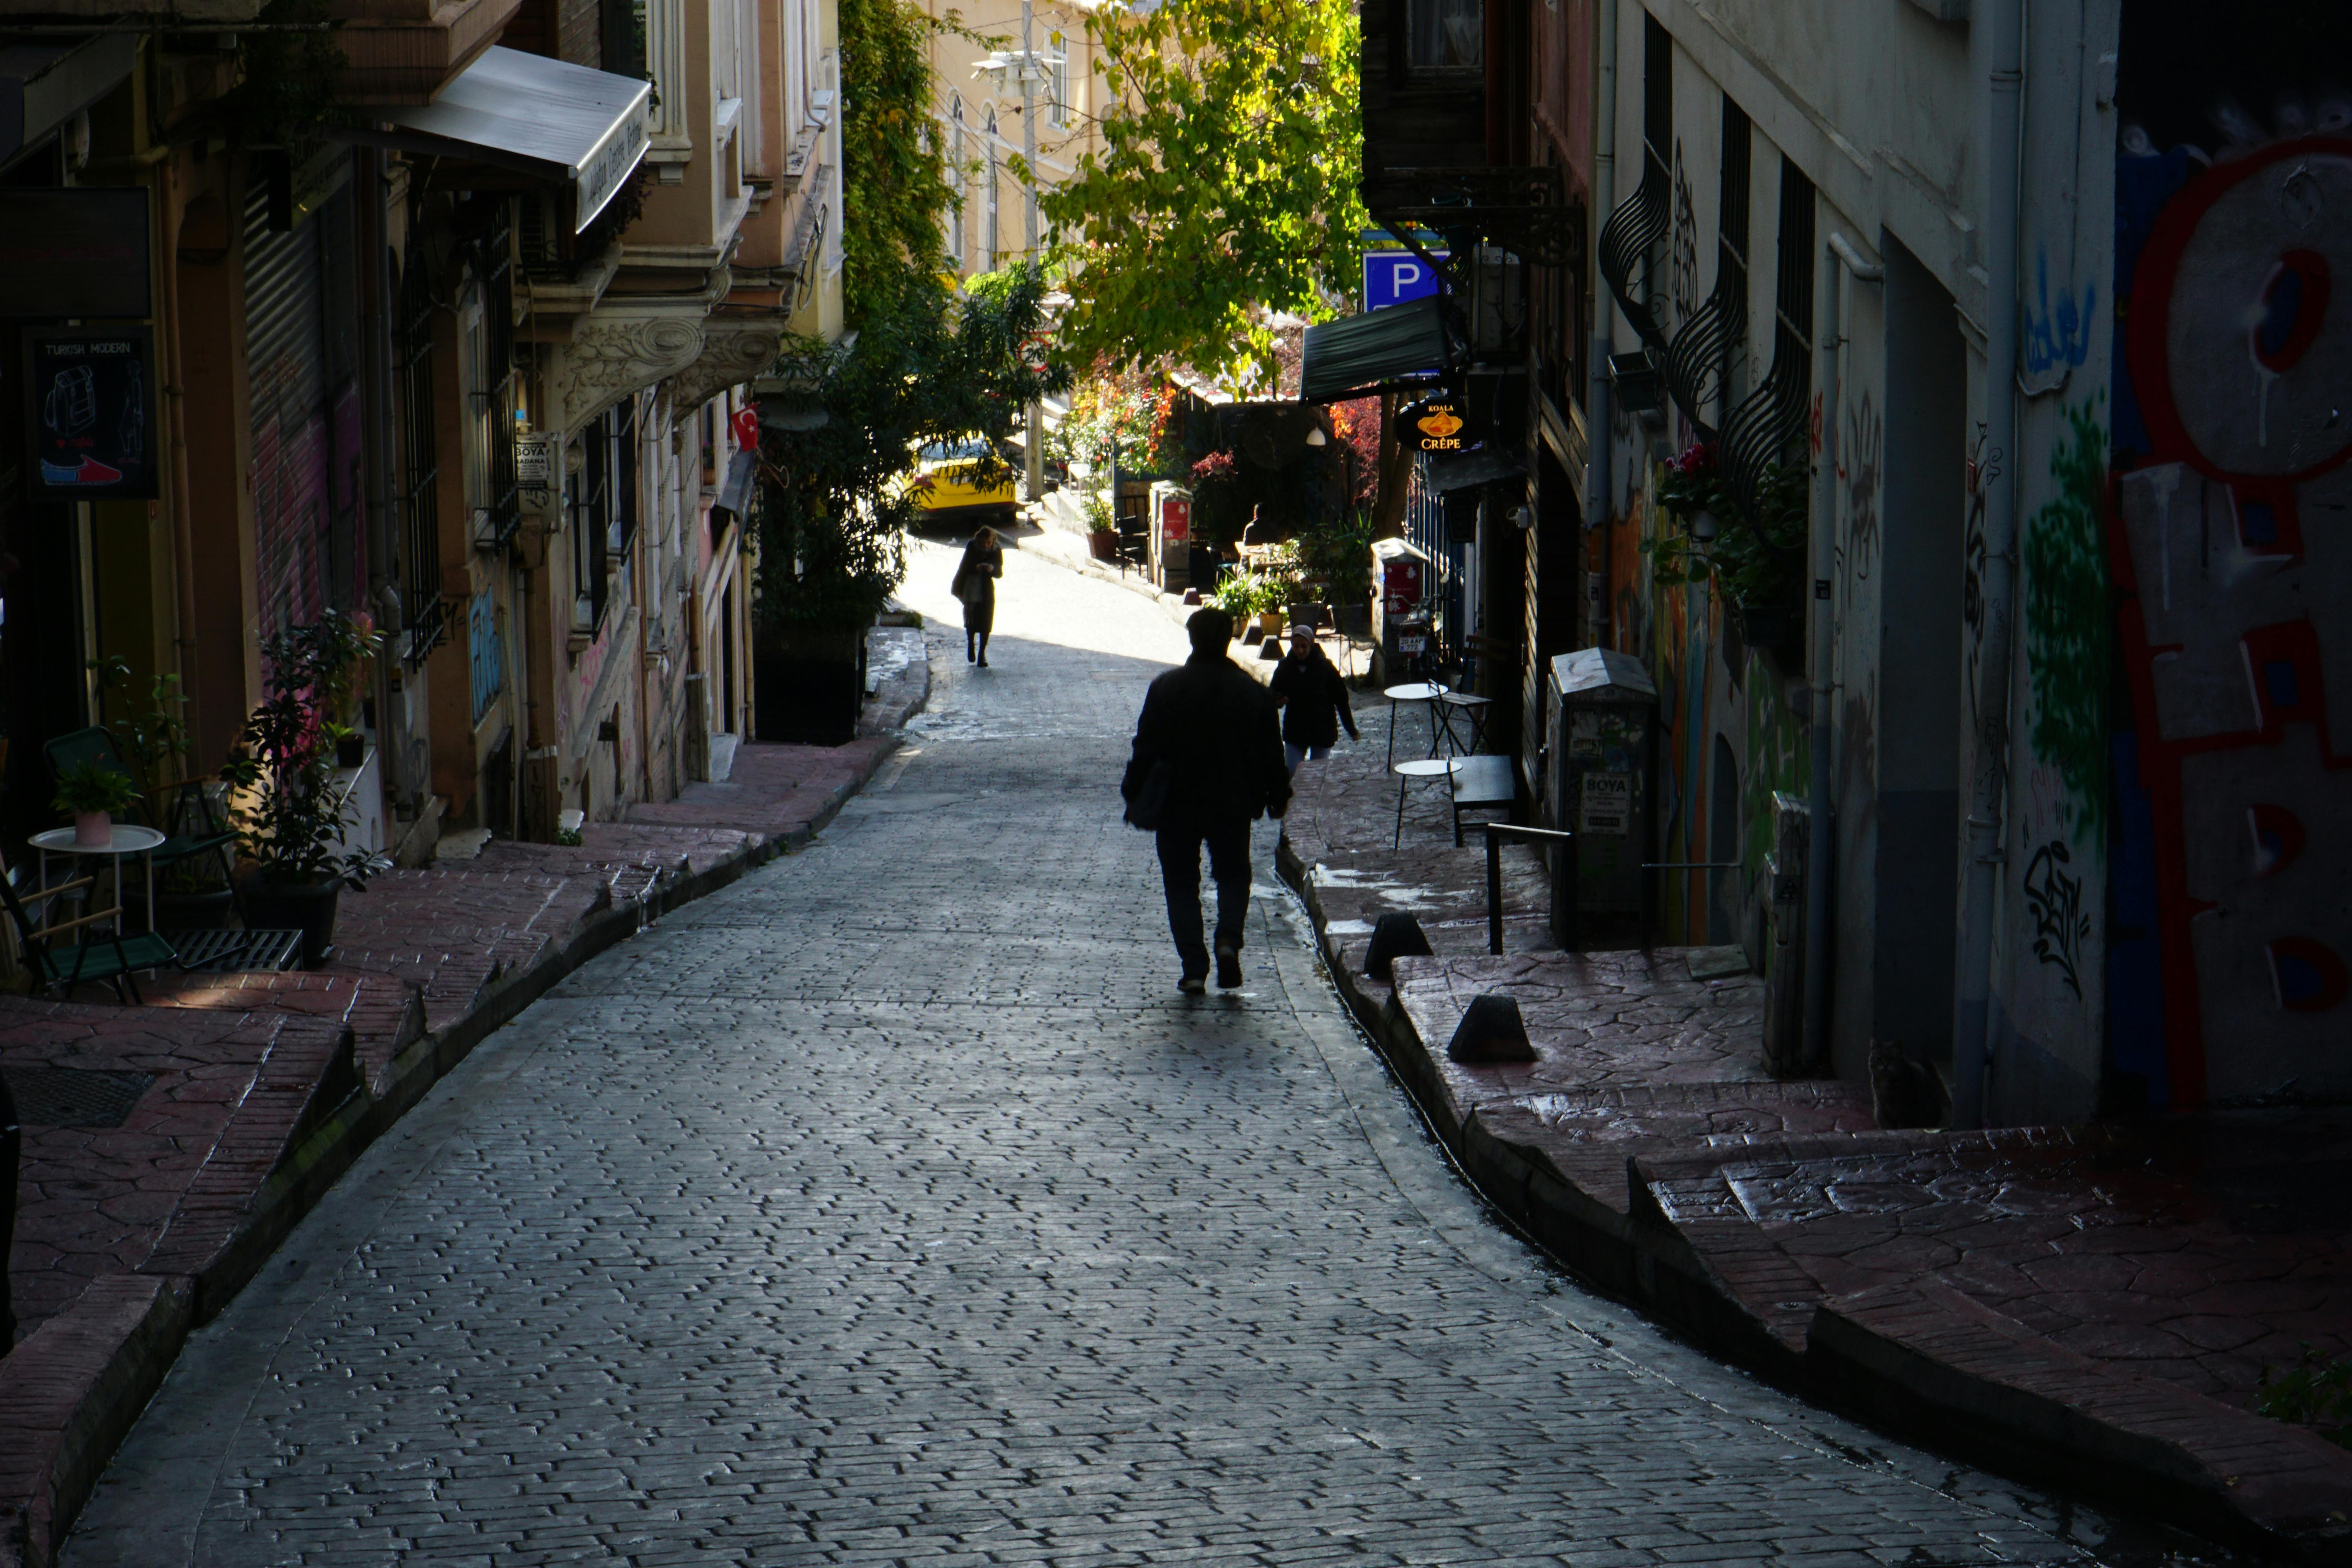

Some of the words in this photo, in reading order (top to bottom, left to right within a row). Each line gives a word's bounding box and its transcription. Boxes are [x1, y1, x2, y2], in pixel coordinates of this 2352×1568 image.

[1394, 263, 1420, 298] P
[45, 344, 84, 355] TURKISH
[91, 343, 130, 354] MODERN
[1421, 437, 1461, 450] CRÊPE
[1587, 779, 1626, 792] BOYA
